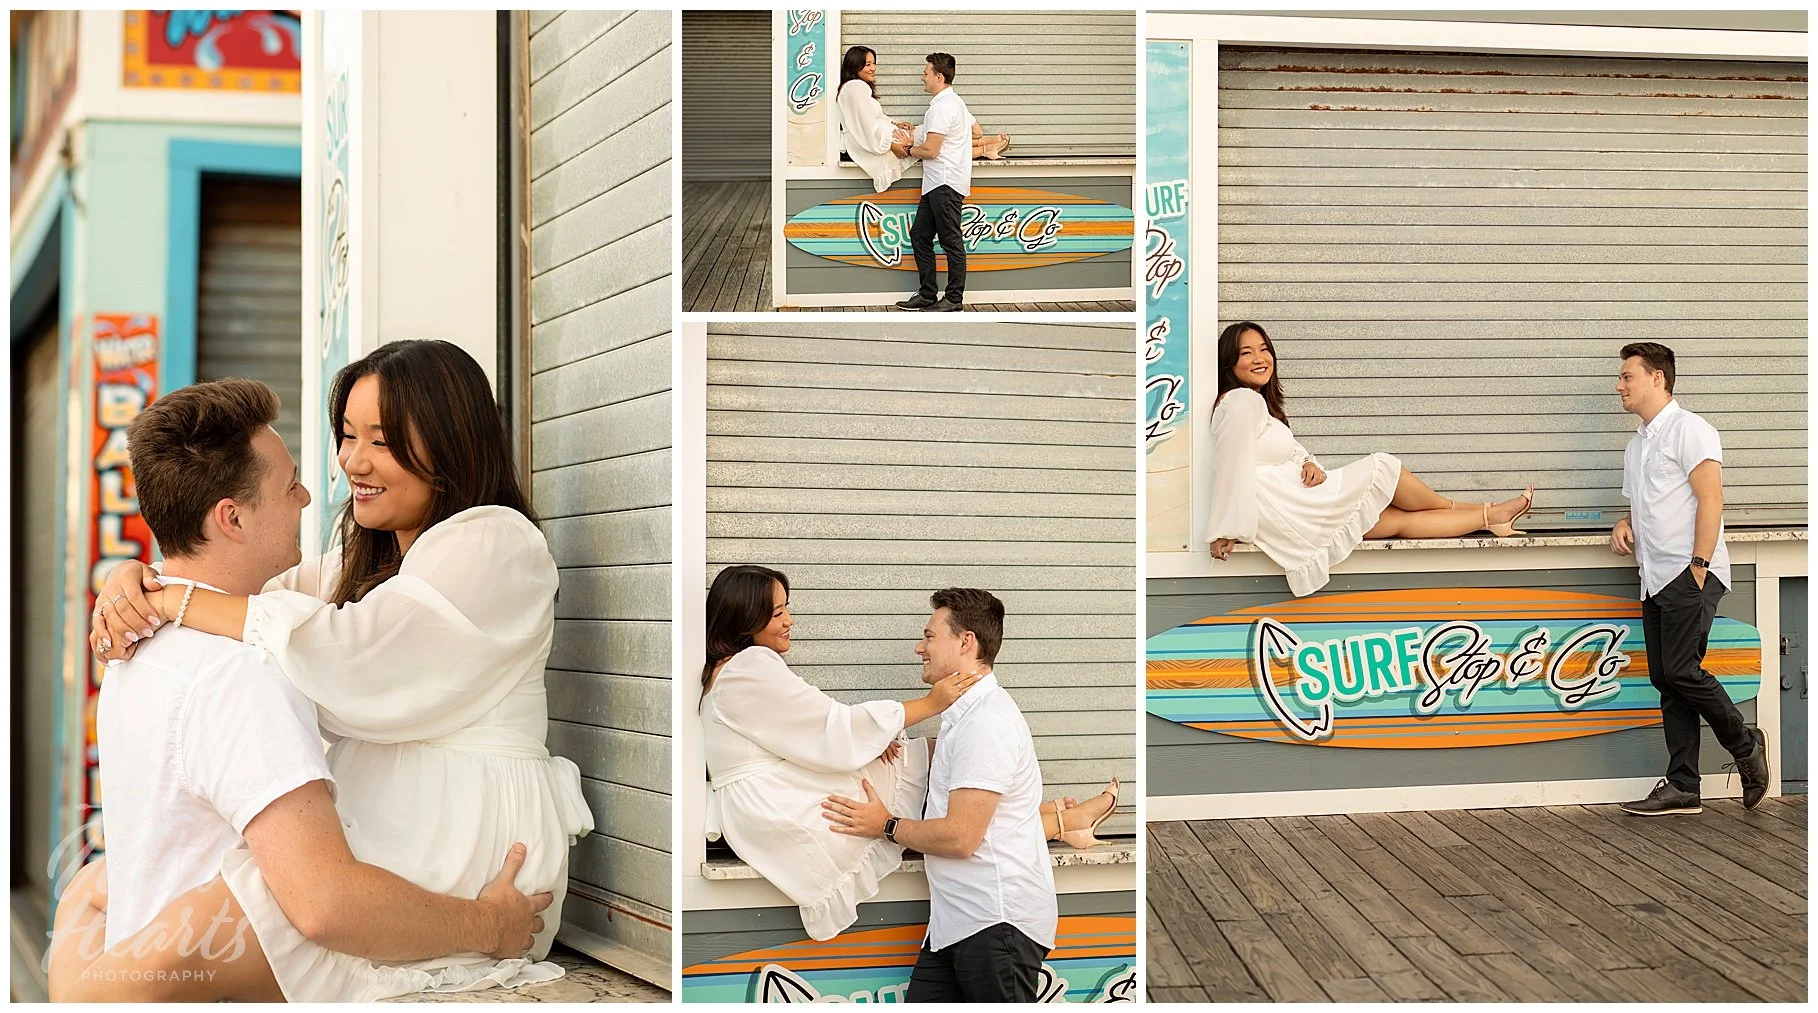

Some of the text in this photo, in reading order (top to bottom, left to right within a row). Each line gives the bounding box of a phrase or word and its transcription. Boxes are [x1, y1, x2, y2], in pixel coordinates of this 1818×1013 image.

[798, 44, 814, 68] &
[791, 73, 821, 109] Go
[1146, 182, 1184, 217] URF
[882, 213, 917, 247] SU
[997, 210, 1018, 238] &
[1019, 209, 1061, 250] Go
[1299, 625, 1631, 707] SURF Stop & Go
